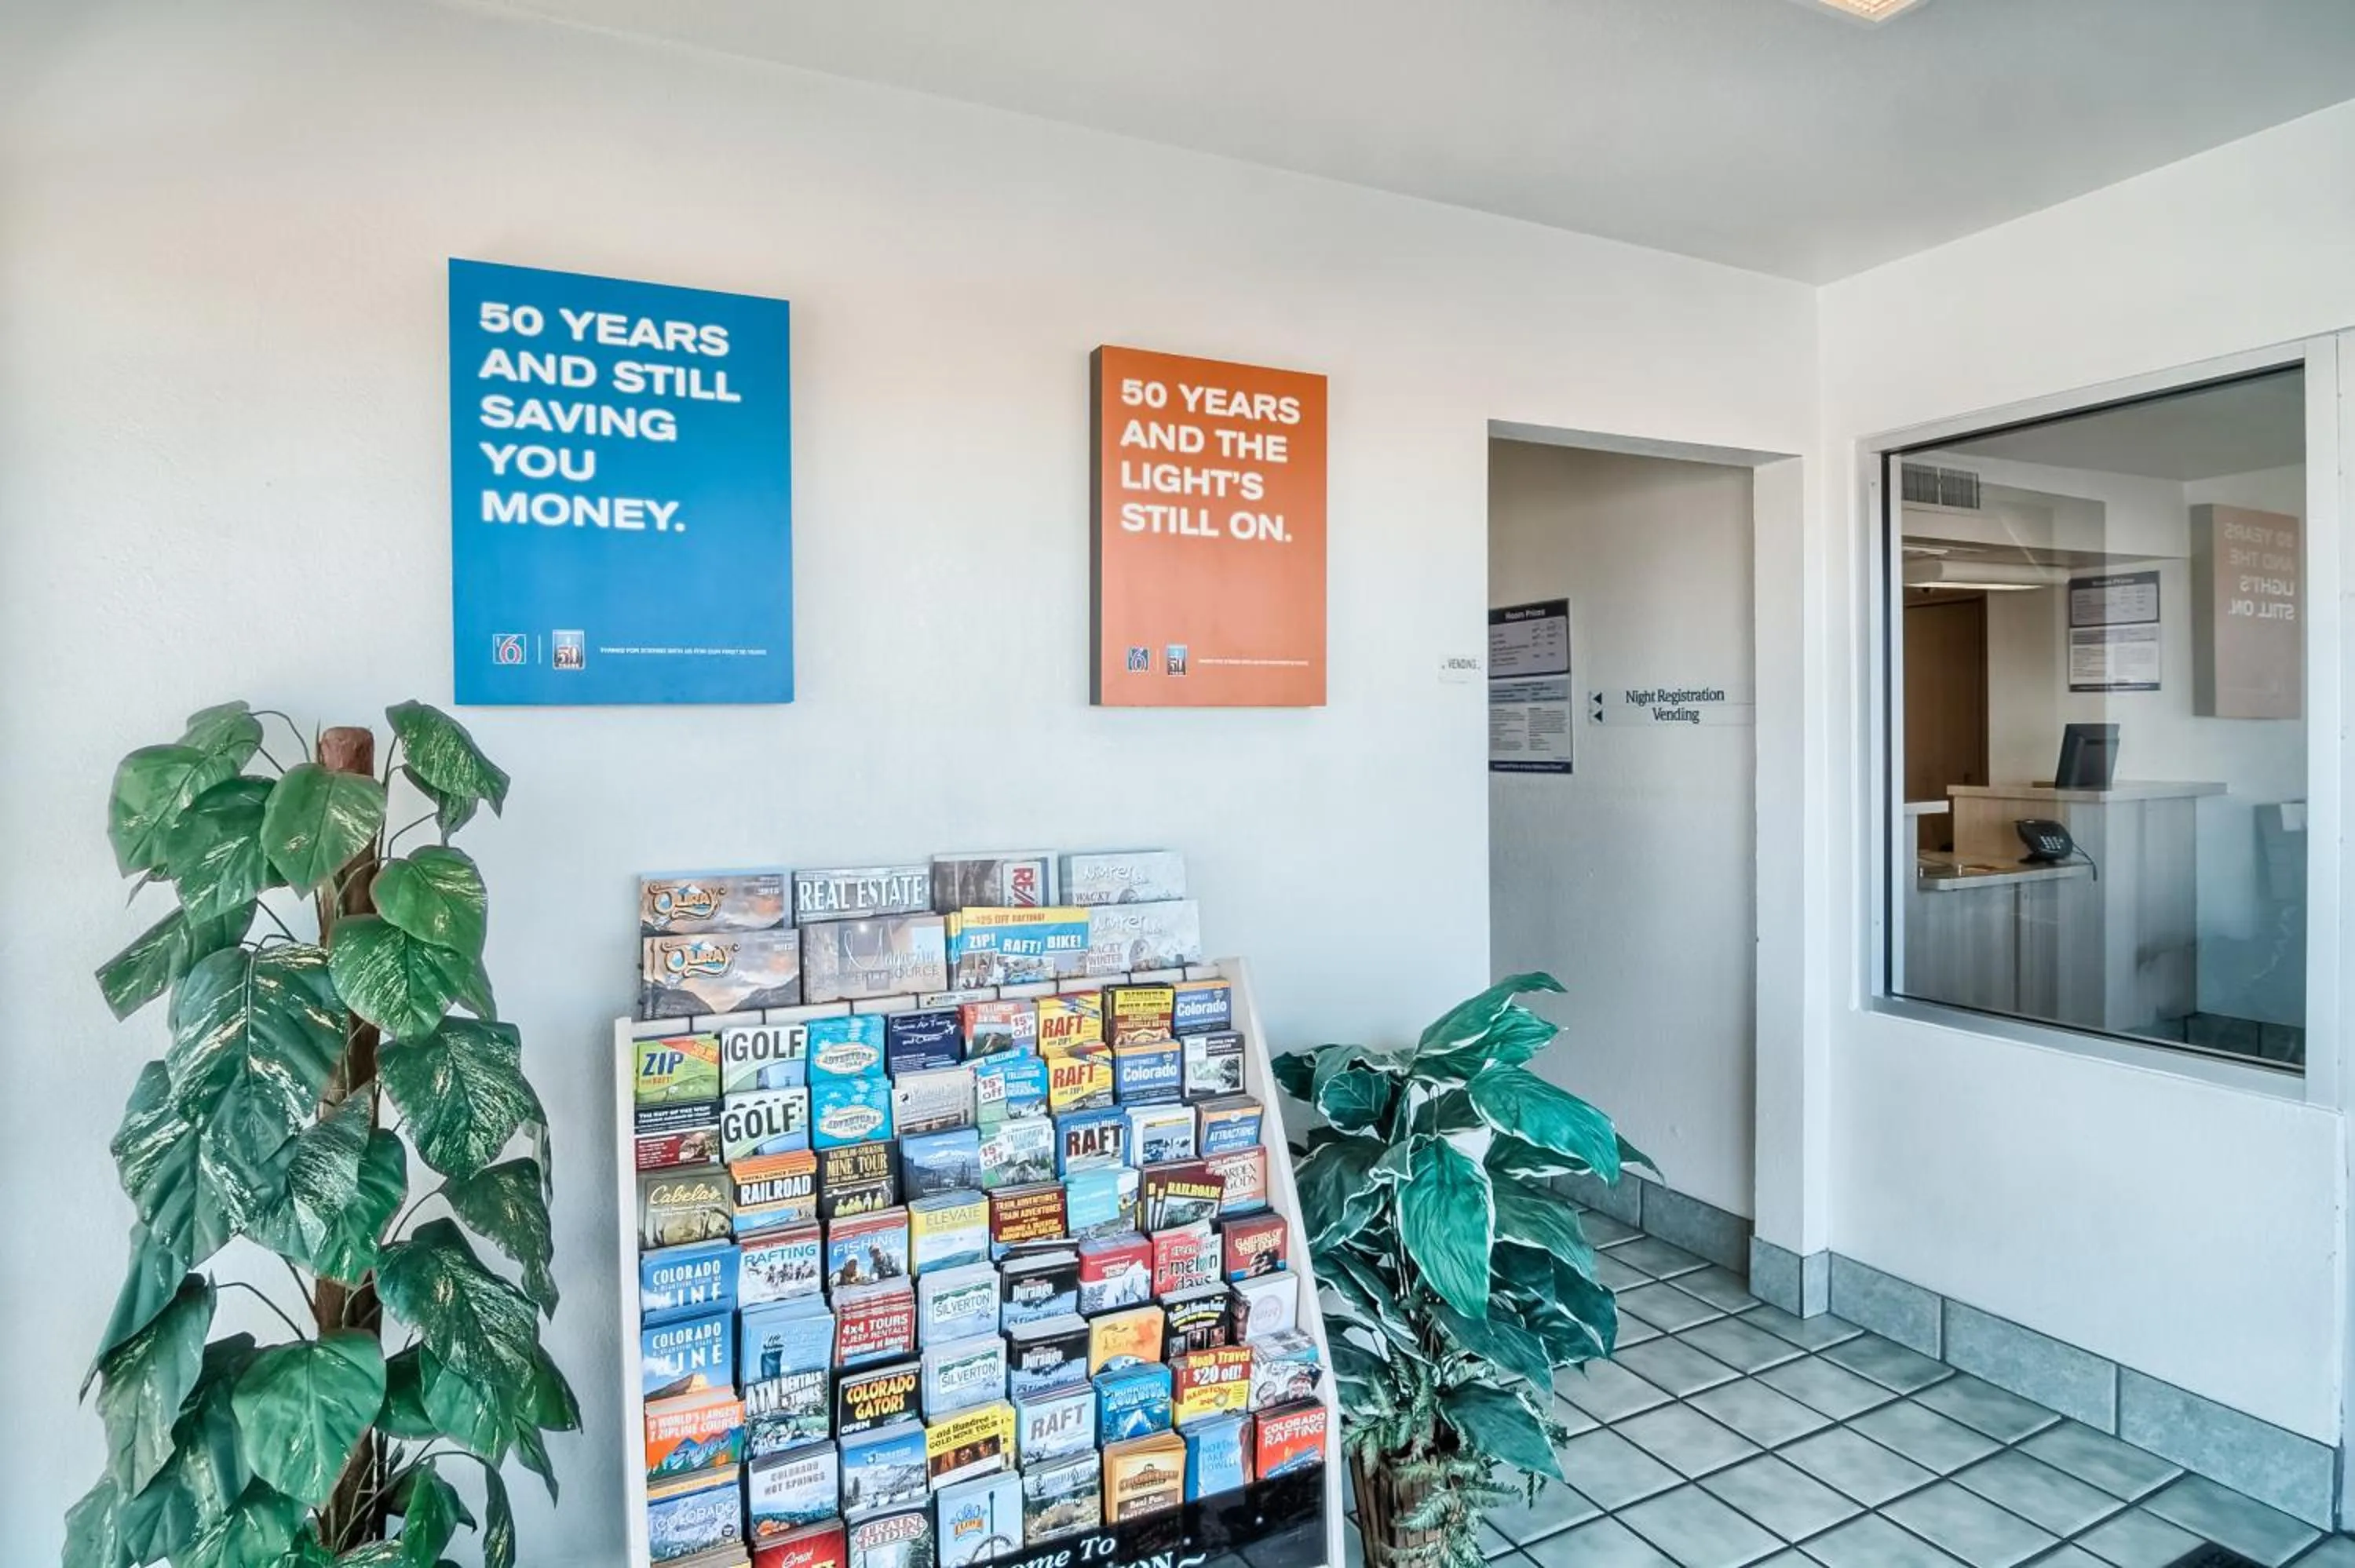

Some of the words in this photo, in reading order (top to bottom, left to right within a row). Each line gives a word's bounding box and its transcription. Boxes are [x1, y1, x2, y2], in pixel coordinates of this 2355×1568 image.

[479, 301, 544, 337] 50
[559, 307, 730, 357] YEARS
[478, 348, 597, 388] AND
[612, 360, 742, 403] STILL
[1120, 378, 1167, 408] 50
[1178, 382, 1301, 425] YEARS
[479, 394, 678, 443] SAVING
[1119, 419, 1205, 454] AND
[1214, 428, 1287, 463] THE
[479, 442, 596, 482] YOU
[1120, 460, 1264, 501] LIGHT'S
[481, 489, 686, 532] MONEY.
[1120, 502, 1219, 537] STILL
[1229, 511, 1293, 542] ON.
[1625, 689, 1655, 707] Night
[1656, 687, 1725, 706] Registration
[1652, 707, 1700, 724] Vending
[798, 879, 851, 913] REAL
[856, 875, 923, 909] ESTATE
[968, 932, 996, 949] ZIP!
[1002, 938, 1042, 954] RAFT!
[1046, 935, 1081, 949] BIKE!
[1176, 998, 1227, 1017] Colorado
[1042, 1016, 1083, 1038] RAFT
[730, 1028, 805, 1062] GOLF
[642, 1051, 685, 1077] ZIP
[1052, 1064, 1095, 1089] RAFT
[1123, 1064, 1178, 1083] Colorado
[723, 1100, 798, 1143] GOLF
[1065, 1124, 1123, 1158] RAFT
[827, 1159, 853, 1178] MINE
[856, 1153, 889, 1175] TOUR
[740, 1175, 812, 1206] RAILROAD
[926, 1209, 981, 1227] ELEVATE
[999, 1209, 1020, 1222] TRAIN
[744, 1244, 816, 1267] RAFTING
[833, 1232, 900, 1256] FISHING
[652, 1260, 721, 1285] COLORADO
[1170, 1253, 1218, 1277] melon
[935, 1293, 990, 1317] SILVERTON
[652, 1322, 721, 1349] COLORADO
[842, 1322, 864, 1336] 4x4
[868, 1313, 908, 1331] TOURS
[1218, 1348, 1251, 1365] Travel
[941, 1362, 996, 1387] SILVERTON
[1192, 1364, 1219, 1385] $20
[1221, 1363, 1243, 1382] off!
[746, 1379, 780, 1415] ATV
[781, 1373, 823, 1392] RENTALS
[846, 1375, 916, 1404] COLORADO
[855, 1395, 905, 1420] GATORS
[841, 1420, 871, 1434] OPEN
[929, 1437, 951, 1449] GOLD
[954, 1430, 975, 1442] MINE
[977, 1420, 998, 1434] TOUR
[937, 1425, 951, 1439] Old
[952, 1415, 988, 1433] Hundred
[1030, 1403, 1087, 1442] RAFT
[1264, 1412, 1326, 1436] COLORADO
[1263, 1424, 1324, 1448] RAFTING
[770, 1461, 820, 1482] COLORADO
[784, 1473, 826, 1491] SPRINGS
[655, 1500, 736, 1530] COLORADO
[864, 1515, 920, 1537] TRAIN
[863, 1528, 921, 1547] RIDES
[1080, 1534, 1116, 1561] To
